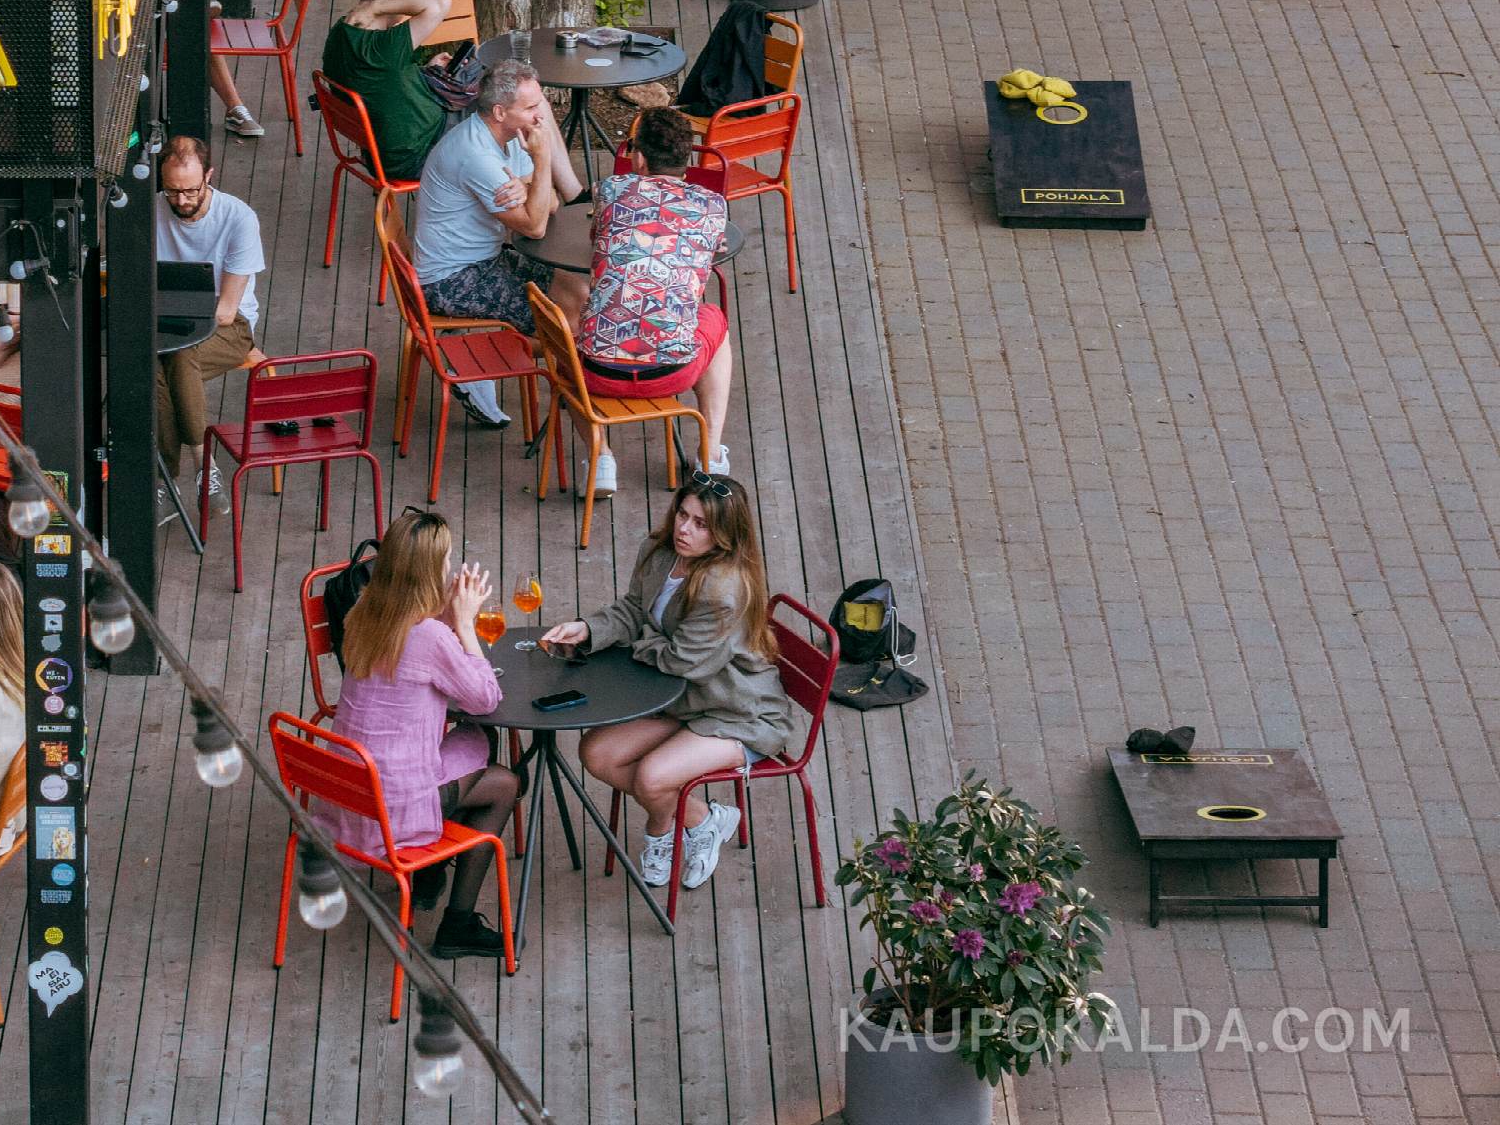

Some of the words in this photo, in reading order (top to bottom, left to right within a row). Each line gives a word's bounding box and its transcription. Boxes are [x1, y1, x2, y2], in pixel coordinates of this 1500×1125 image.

[35, 966, 53, 980] MA
[48, 971, 71, 988] SAA
[49, 969, 60, 979] EI
[50, 978, 71, 997] ARU
